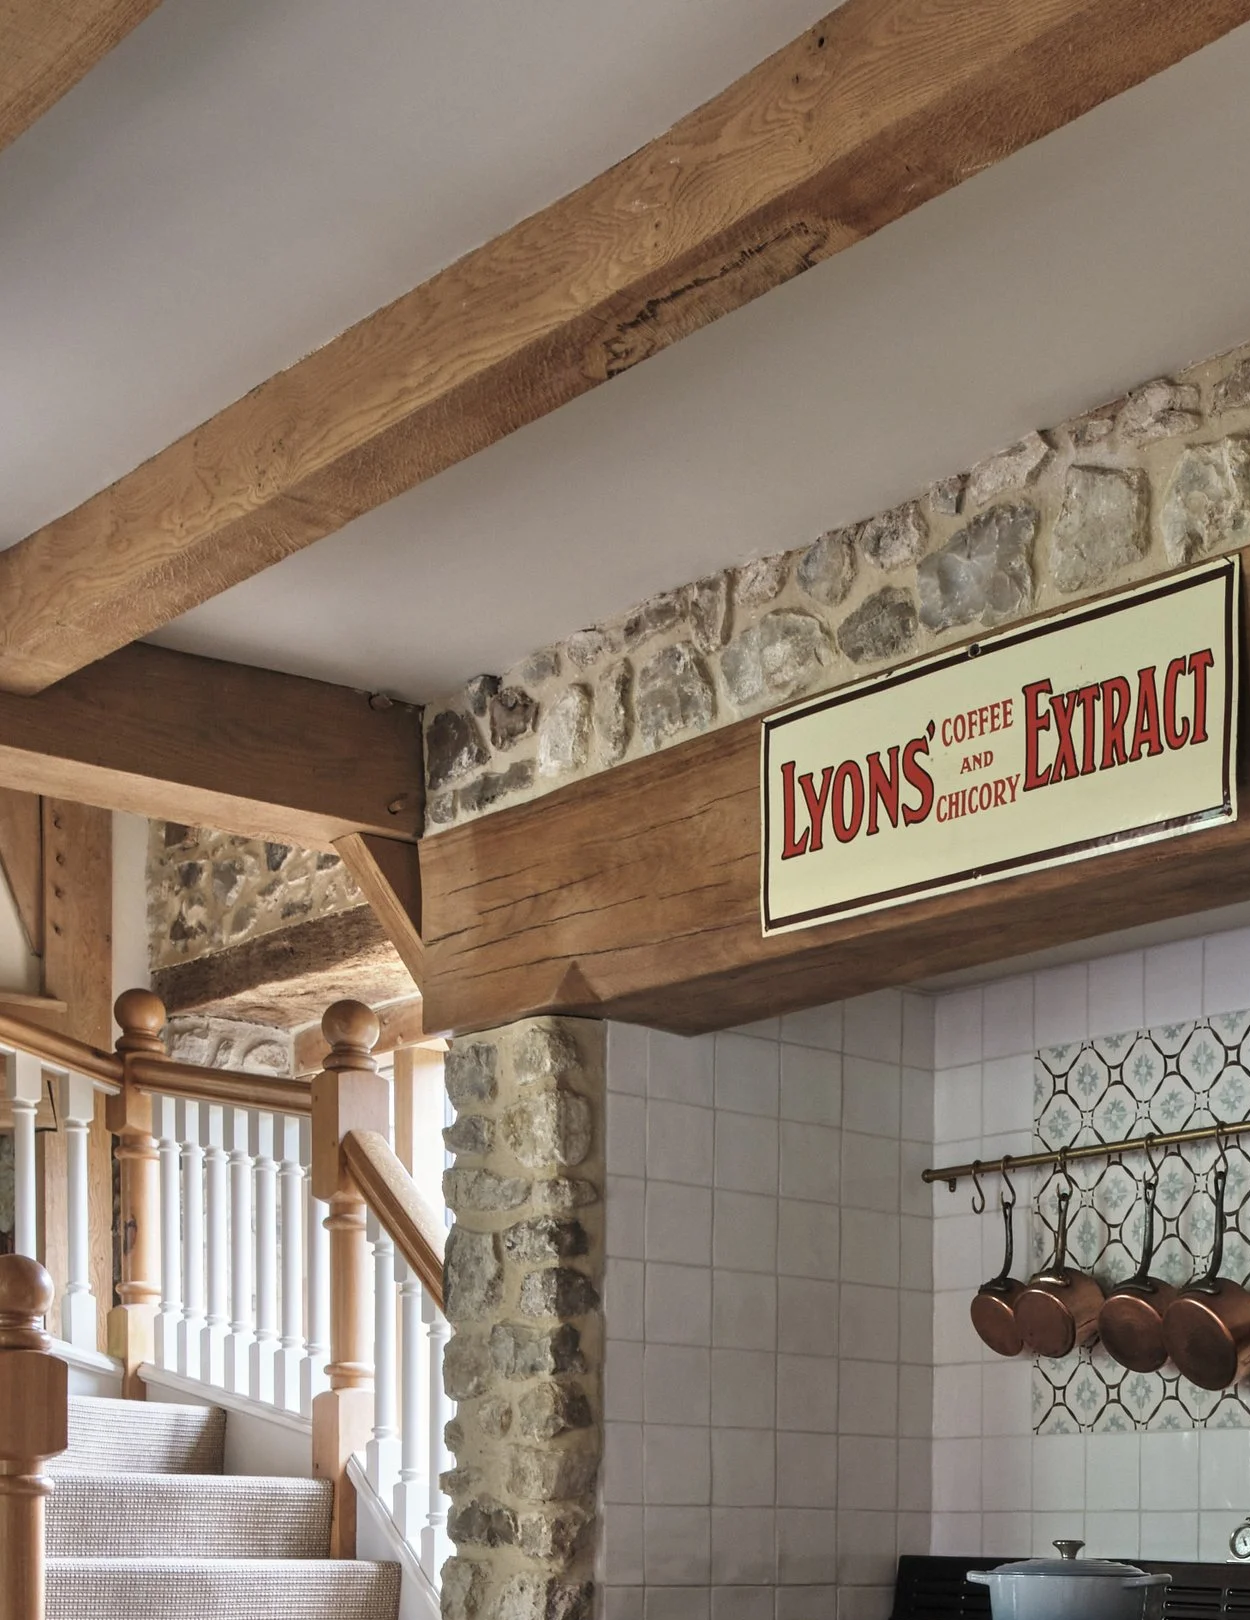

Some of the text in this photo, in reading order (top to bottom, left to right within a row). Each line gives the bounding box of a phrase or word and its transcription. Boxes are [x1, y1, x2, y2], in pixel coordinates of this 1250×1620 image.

[941, 698, 1014, 747] COFFEE
[1022, 648, 1214, 792] EXTRACT
[960, 750, 994, 774] AND
[936, 774, 1021, 823] CHICORY
